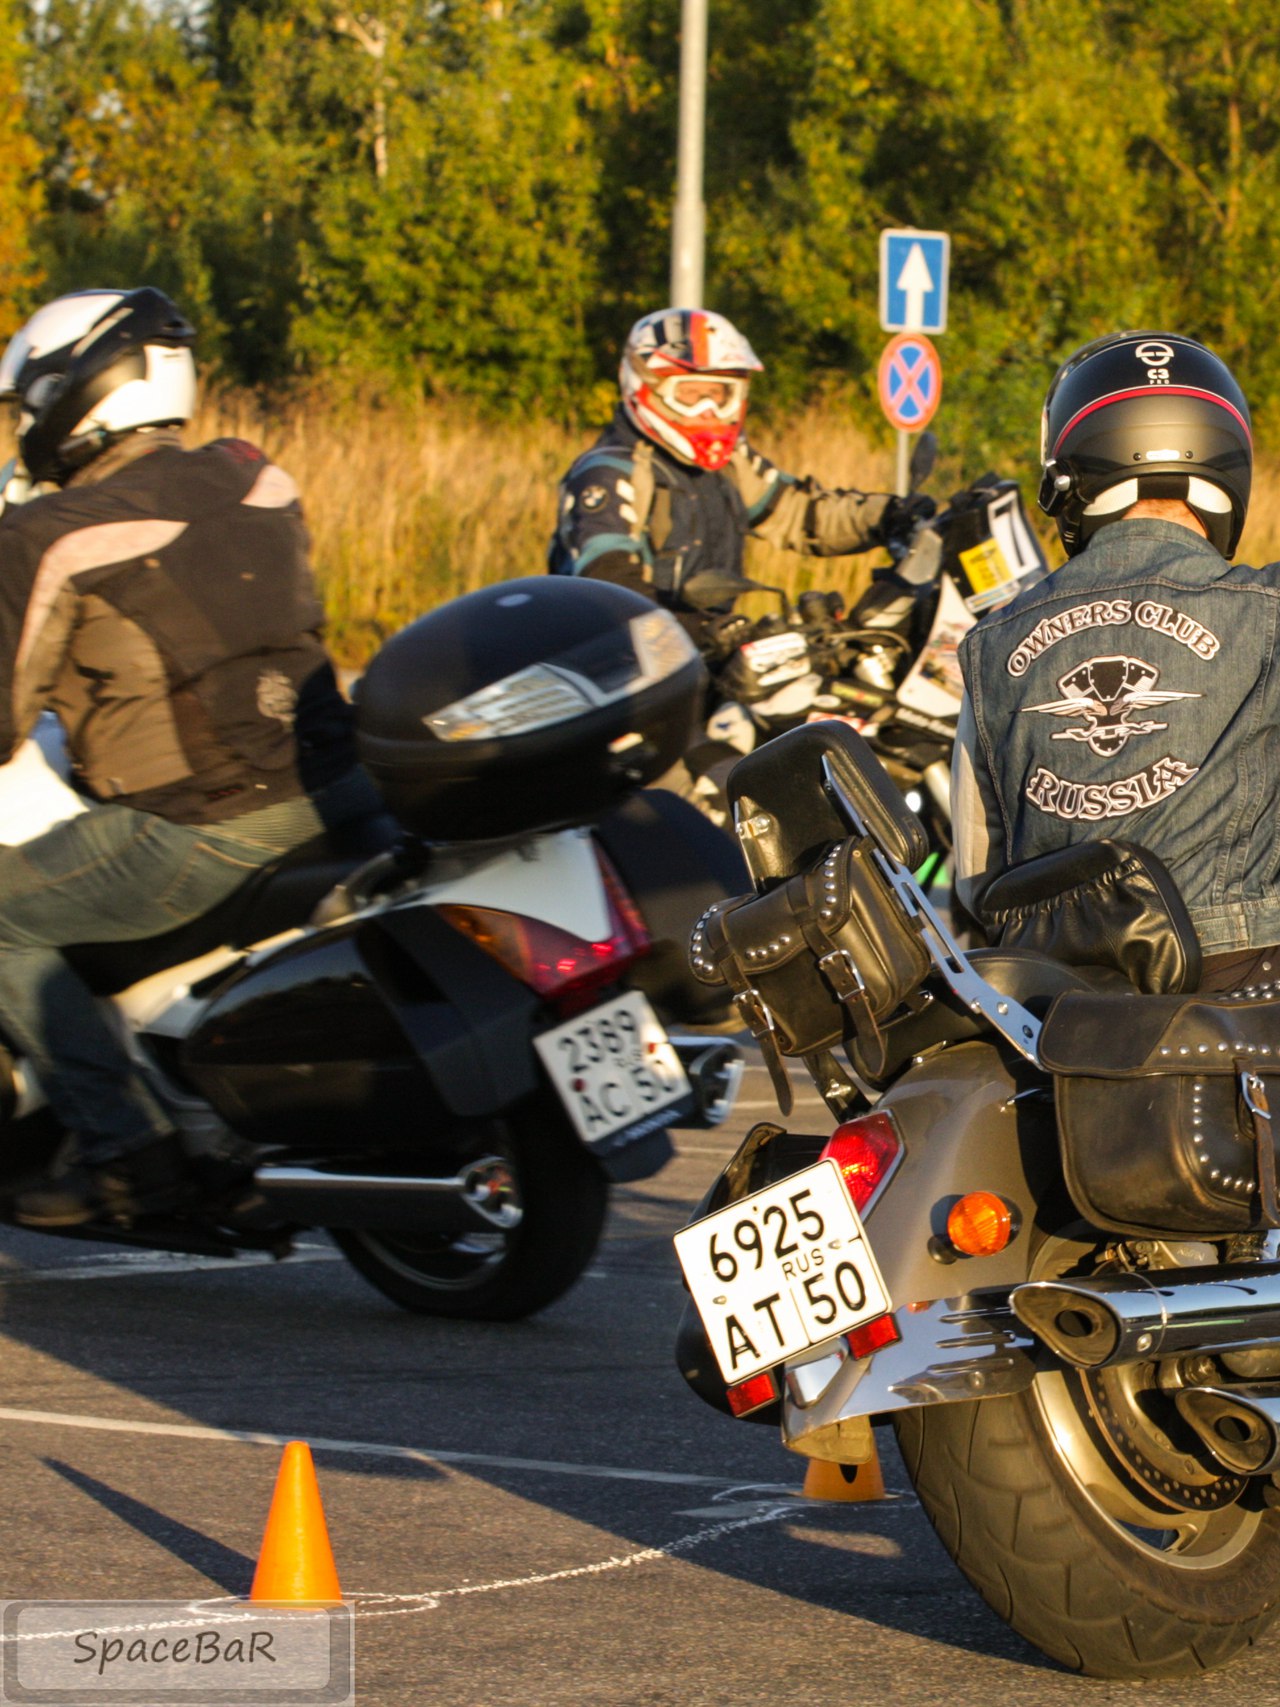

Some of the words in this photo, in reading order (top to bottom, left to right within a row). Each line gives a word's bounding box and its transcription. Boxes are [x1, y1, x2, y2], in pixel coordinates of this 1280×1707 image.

[1147, 368, 1170, 380] C3
[1007, 599, 1133, 677] OWNERS
[1134, 600, 1221, 661] CLUB
[1026, 757, 1199, 820] RUSSIA
[558, 1009, 641, 1073] 2389
[580, 1082, 632, 1133] AC
[709, 1188, 825, 1283] 6925
[781, 1248, 825, 1281] RUS
[726, 1292, 786, 1370] AT
[802, 1260, 867, 1325] 50
